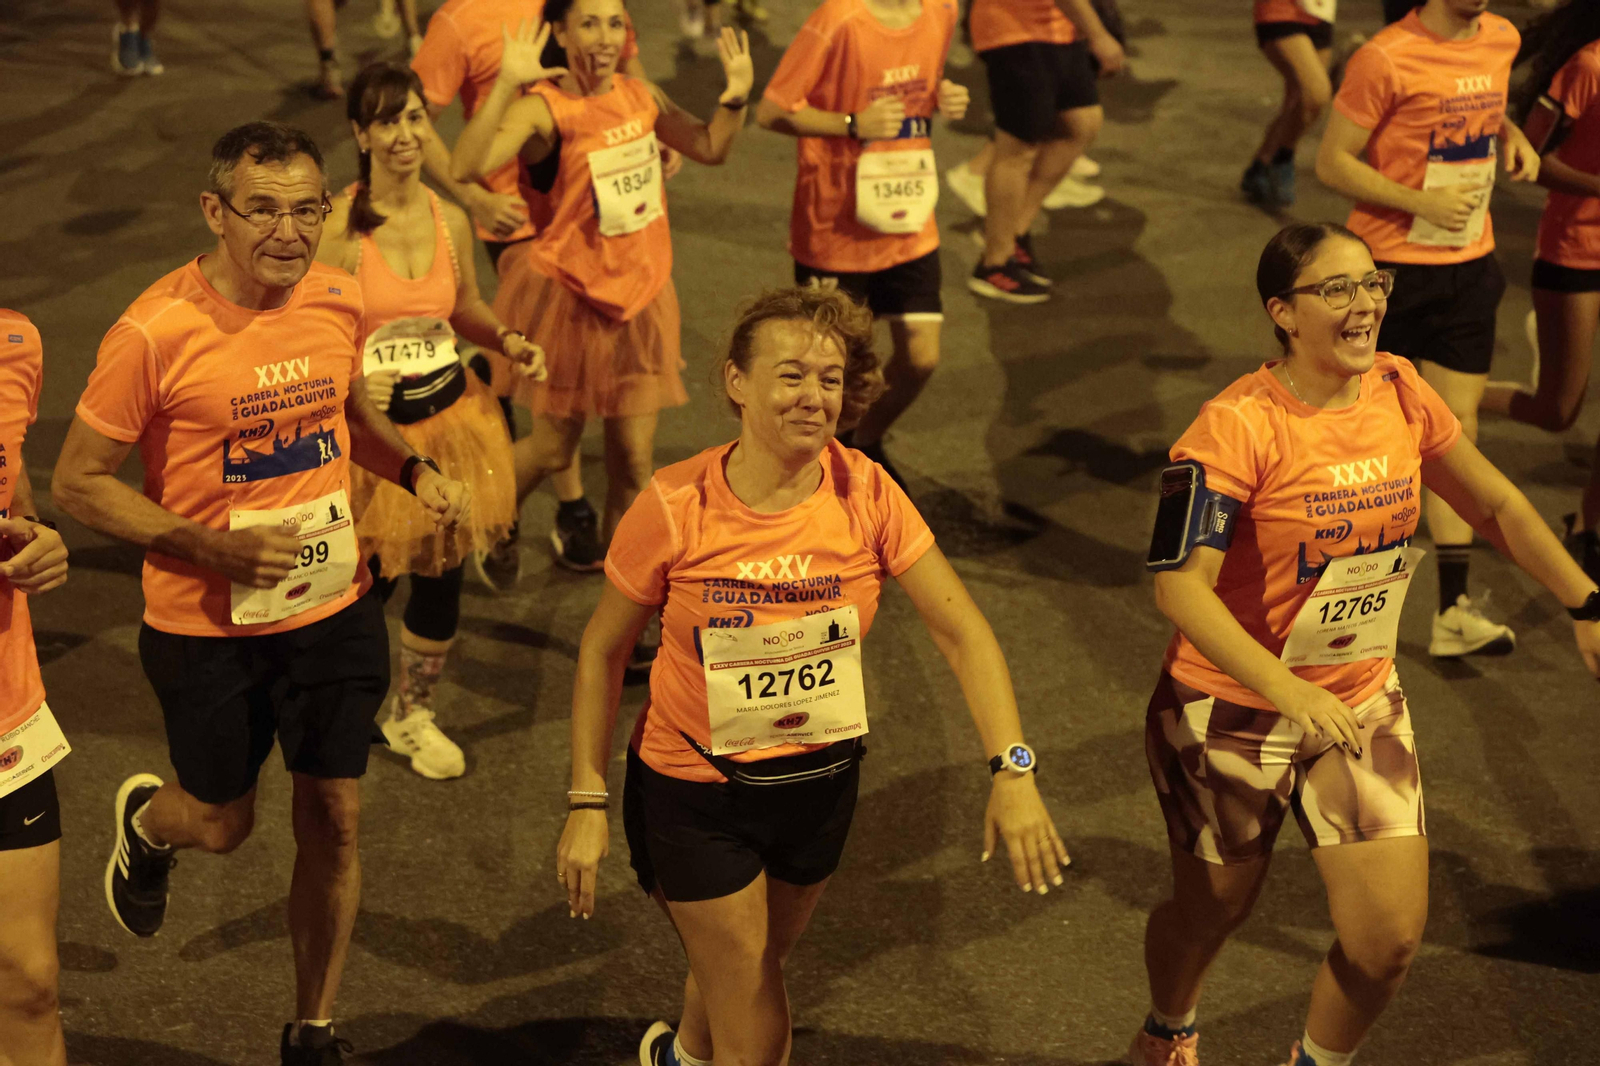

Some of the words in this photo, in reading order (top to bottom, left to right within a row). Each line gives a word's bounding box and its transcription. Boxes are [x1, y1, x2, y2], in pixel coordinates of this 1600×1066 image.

[1455, 74, 1491, 94] XXXV
[873, 180, 925, 198] 13465
[372, 340, 436, 364] 17479
[254, 356, 310, 389] XXXV
[231, 389, 280, 406] CARRERA
[284, 377, 334, 395] NOCTURNA
[241, 387, 337, 418] GUADALQUIVIR
[1327, 455, 1388, 487] XXXV
[1304, 489, 1357, 503] CARRERA
[1361, 476, 1413, 495] NOCTURNA
[1315, 487, 1414, 516] GUADALQUIVIR
[293, 541, 329, 569] 99
[736, 554, 814, 580] XXXV
[702, 588, 710, 603] DEL
[703, 579, 766, 590] CARRERA
[772, 574, 842, 591] NOCTURNA
[712, 585, 842, 604] GUADALQUIVIR
[1318, 589, 1389, 625] 12765
[754, 657, 785, 665] NOCTURNA
[738, 659, 836, 700] 12762
[760, 702, 792, 711] DOLORES
[793, 697, 813, 707] LOPEZ
[814, 689, 840, 701] JIMENEZ
